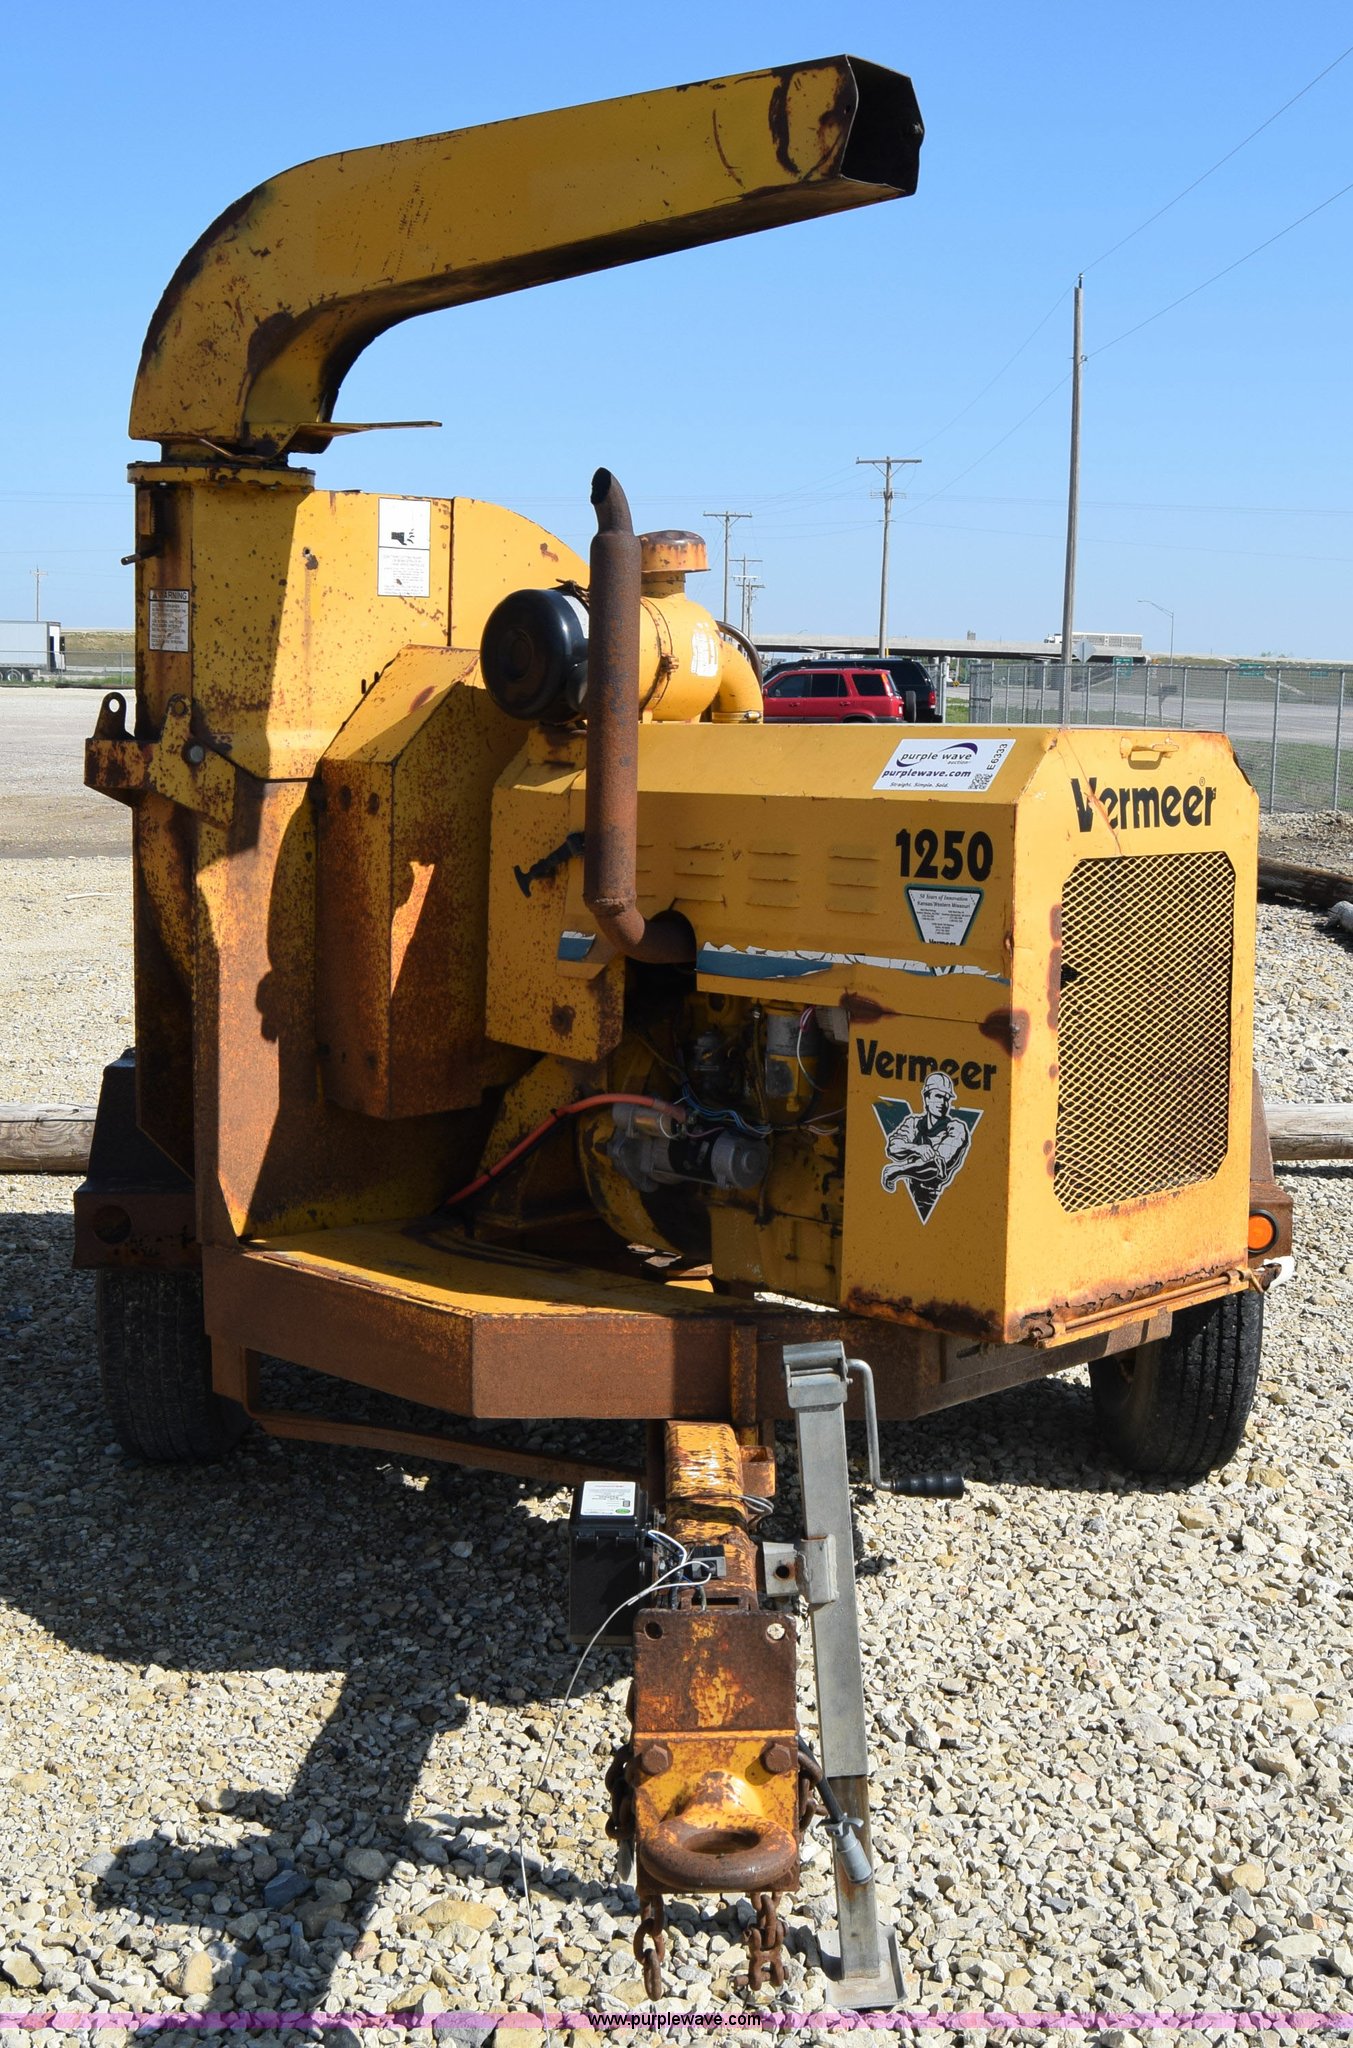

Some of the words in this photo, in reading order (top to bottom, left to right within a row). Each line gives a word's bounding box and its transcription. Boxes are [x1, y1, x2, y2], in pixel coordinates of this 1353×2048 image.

[882, 768, 972, 779] purplewave.com
[901, 752, 939, 762] purple
[986, 743, 1008, 770] E6333
[1070, 777, 1217, 833] Vermeer
[895, 828, 994, 882] 1250
[856, 1037, 998, 1092] Vermeer
